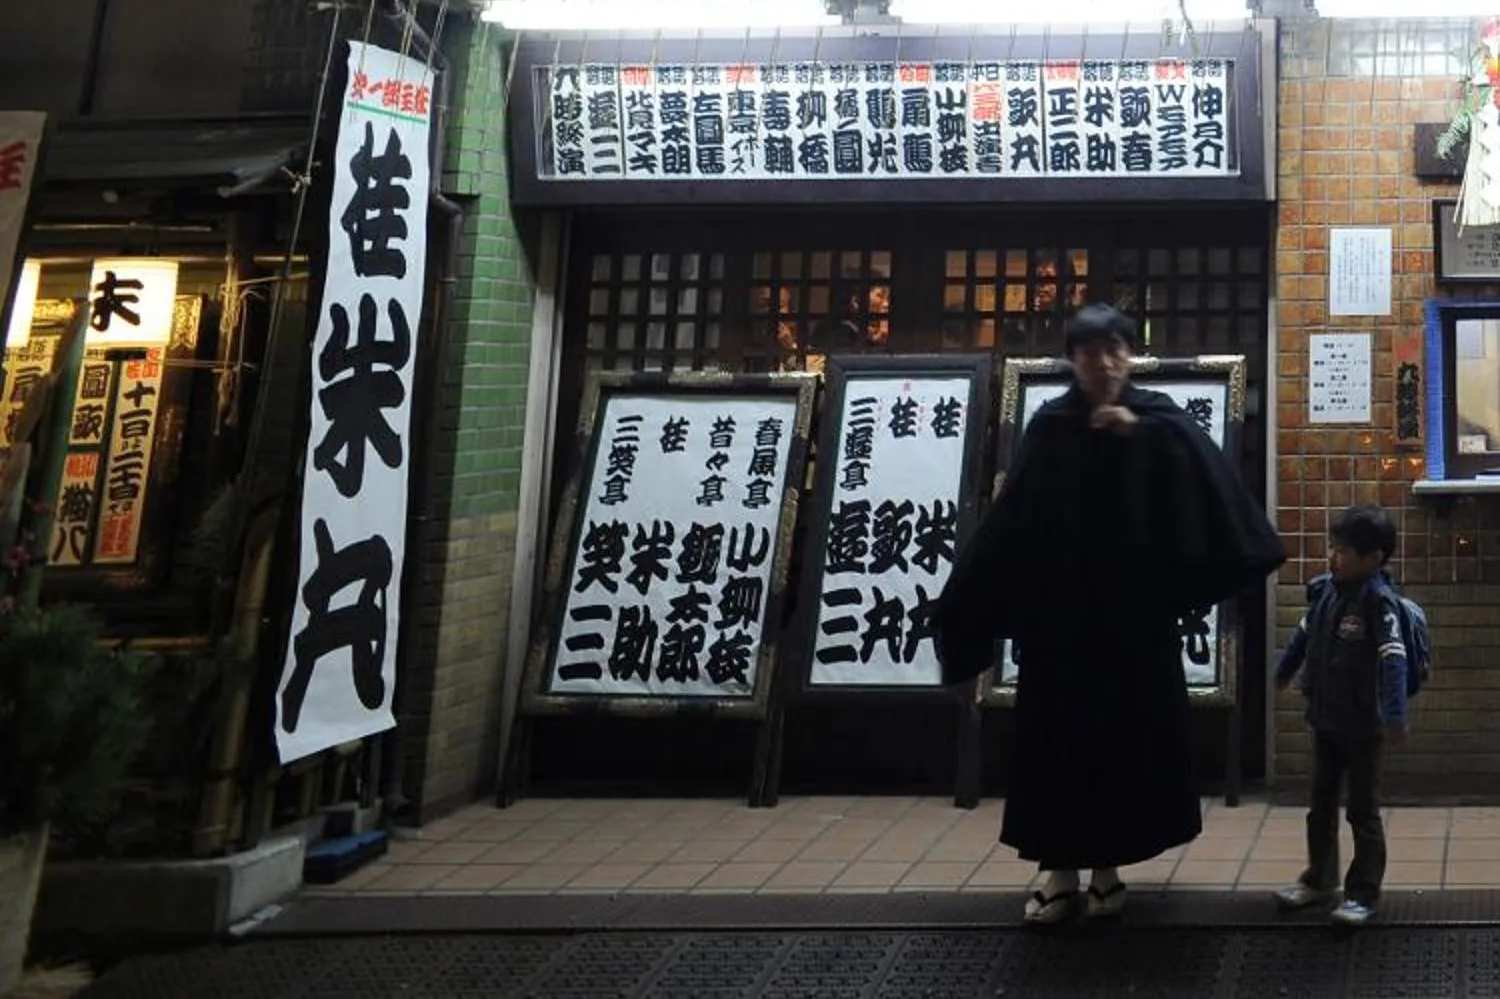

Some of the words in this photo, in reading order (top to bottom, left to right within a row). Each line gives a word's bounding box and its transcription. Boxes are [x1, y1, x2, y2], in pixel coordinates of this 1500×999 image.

[1007, 86, 1041, 173] 歌丸
[1083, 85, 1117, 173] 米助
[1119, 86, 1153, 173] 歌春
[283, 119, 413, 734] 桂米丸
[608, 415, 691, 682] 桂米助
[704, 416, 784, 686] 春風亭小柳枝
[860, 395, 919, 664] 桂歌丸
